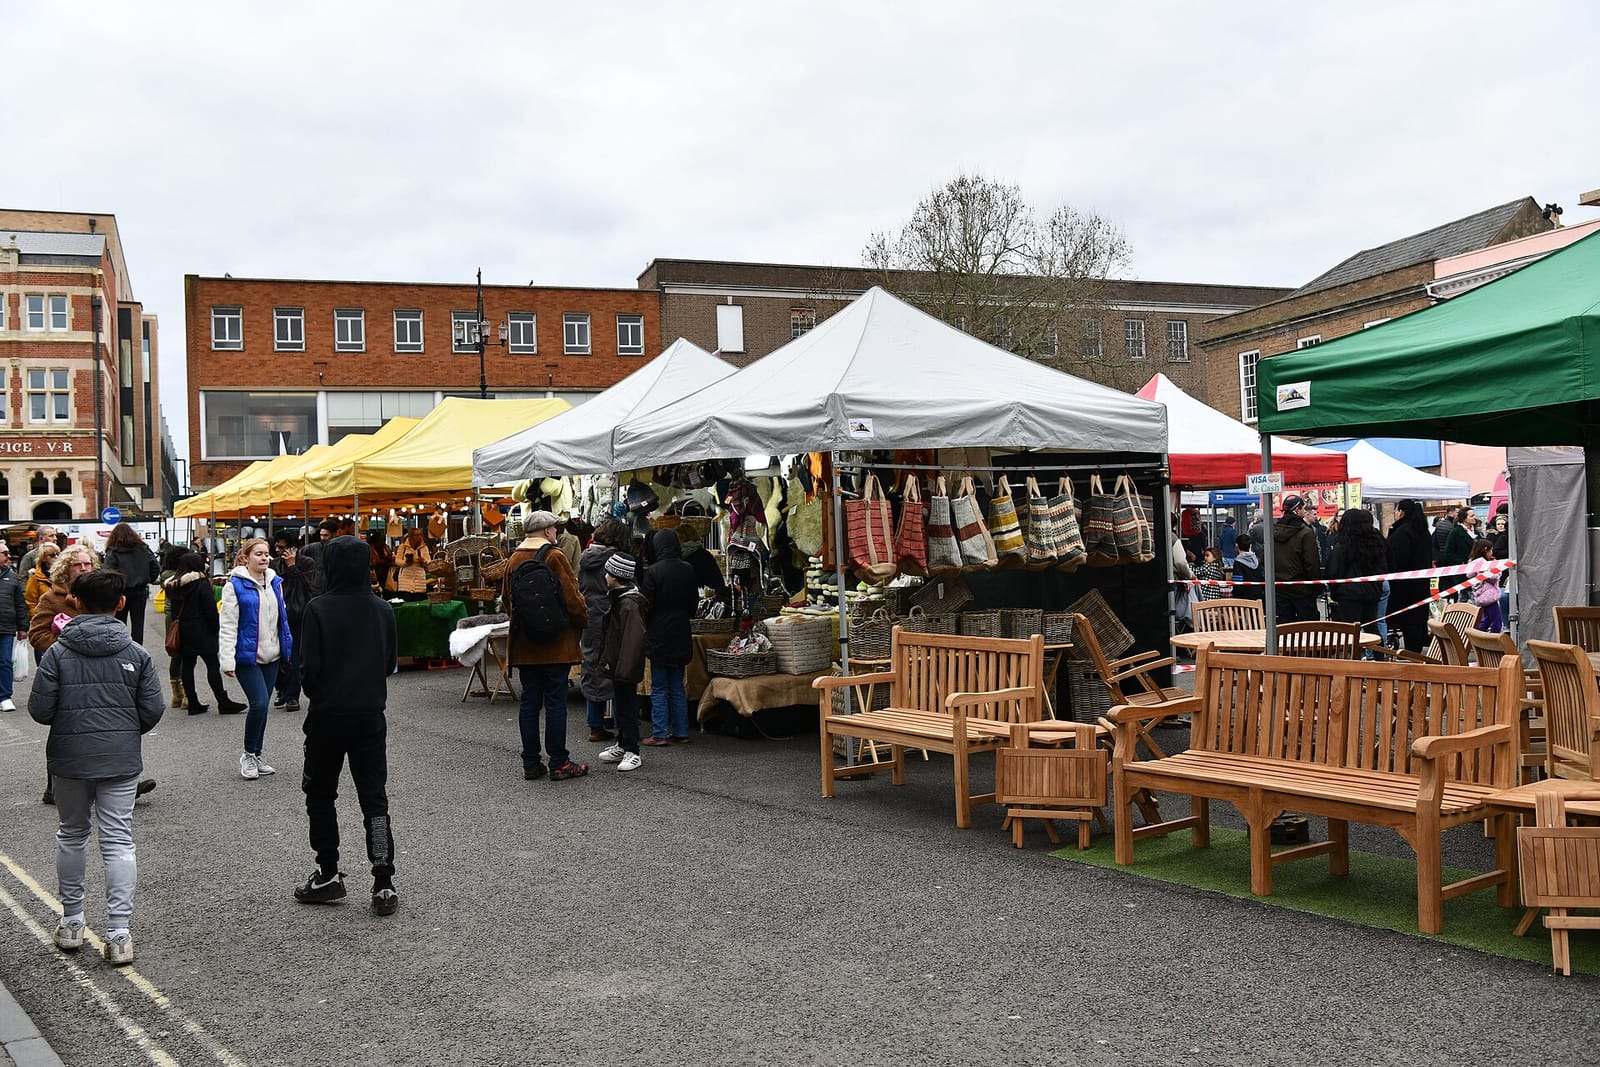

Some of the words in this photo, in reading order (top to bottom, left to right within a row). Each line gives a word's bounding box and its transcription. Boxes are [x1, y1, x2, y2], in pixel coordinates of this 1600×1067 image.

[1250, 475, 1268, 484] VISA
[1252, 485, 1260, 493] &
[1260, 483, 1280, 493] Cash
